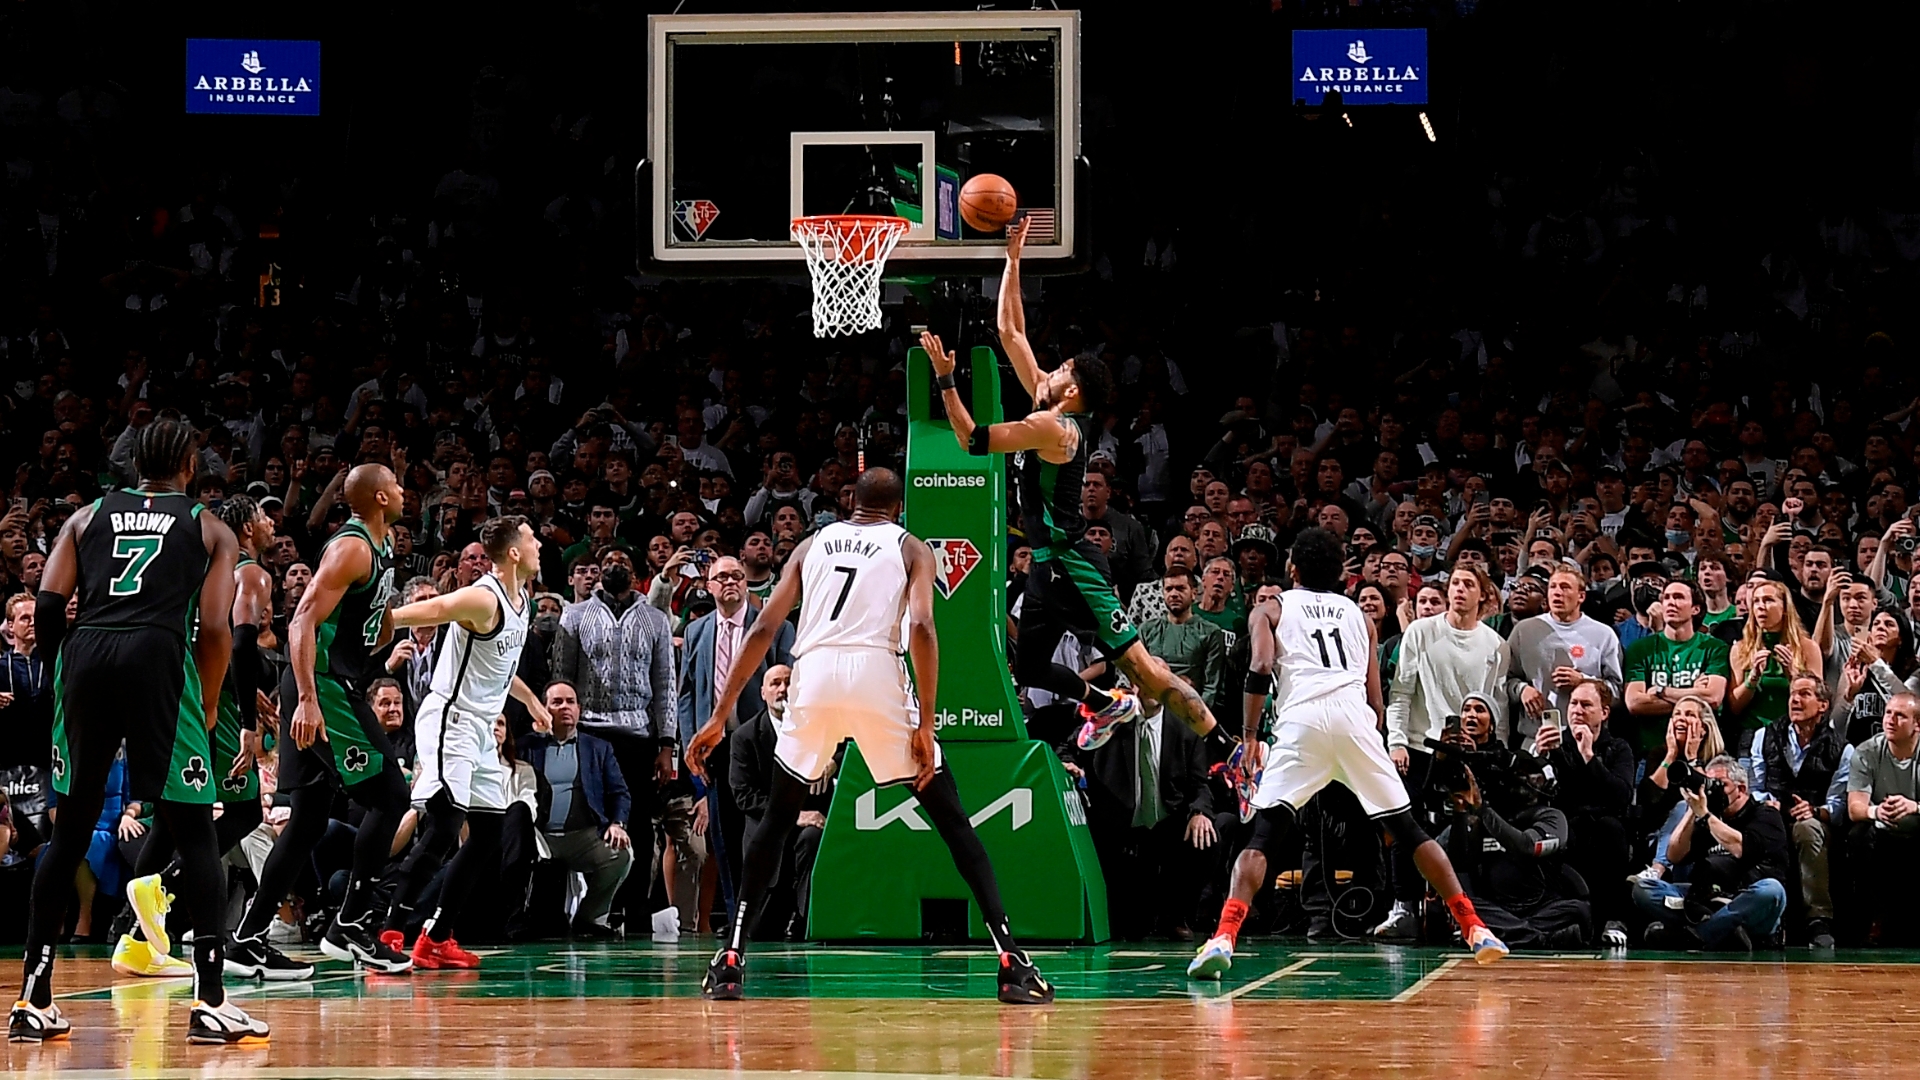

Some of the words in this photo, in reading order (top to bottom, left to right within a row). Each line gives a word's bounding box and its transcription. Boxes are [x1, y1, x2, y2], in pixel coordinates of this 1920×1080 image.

[1300, 66, 1419, 81] ARBELLA
[194, 77, 312, 92] ARBELLA
[1315, 84, 1403, 94] INSURANCE
[209, 93, 296, 104] INSURANCE
[914, 473, 986, 488] coinbase
[110, 511, 176, 535] BROWN
[824, 539, 882, 559] DURANT
[952, 547, 967, 566] 75
[108, 535, 165, 597] 7
[830, 566, 857, 621] 7
[1301, 604, 1345, 620] IRVING
[363, 608, 385, 646] 4
[1311, 627, 1348, 671] 11
[962, 708, 1003, 727] Pixel
[856, 788, 1032, 831] KA
